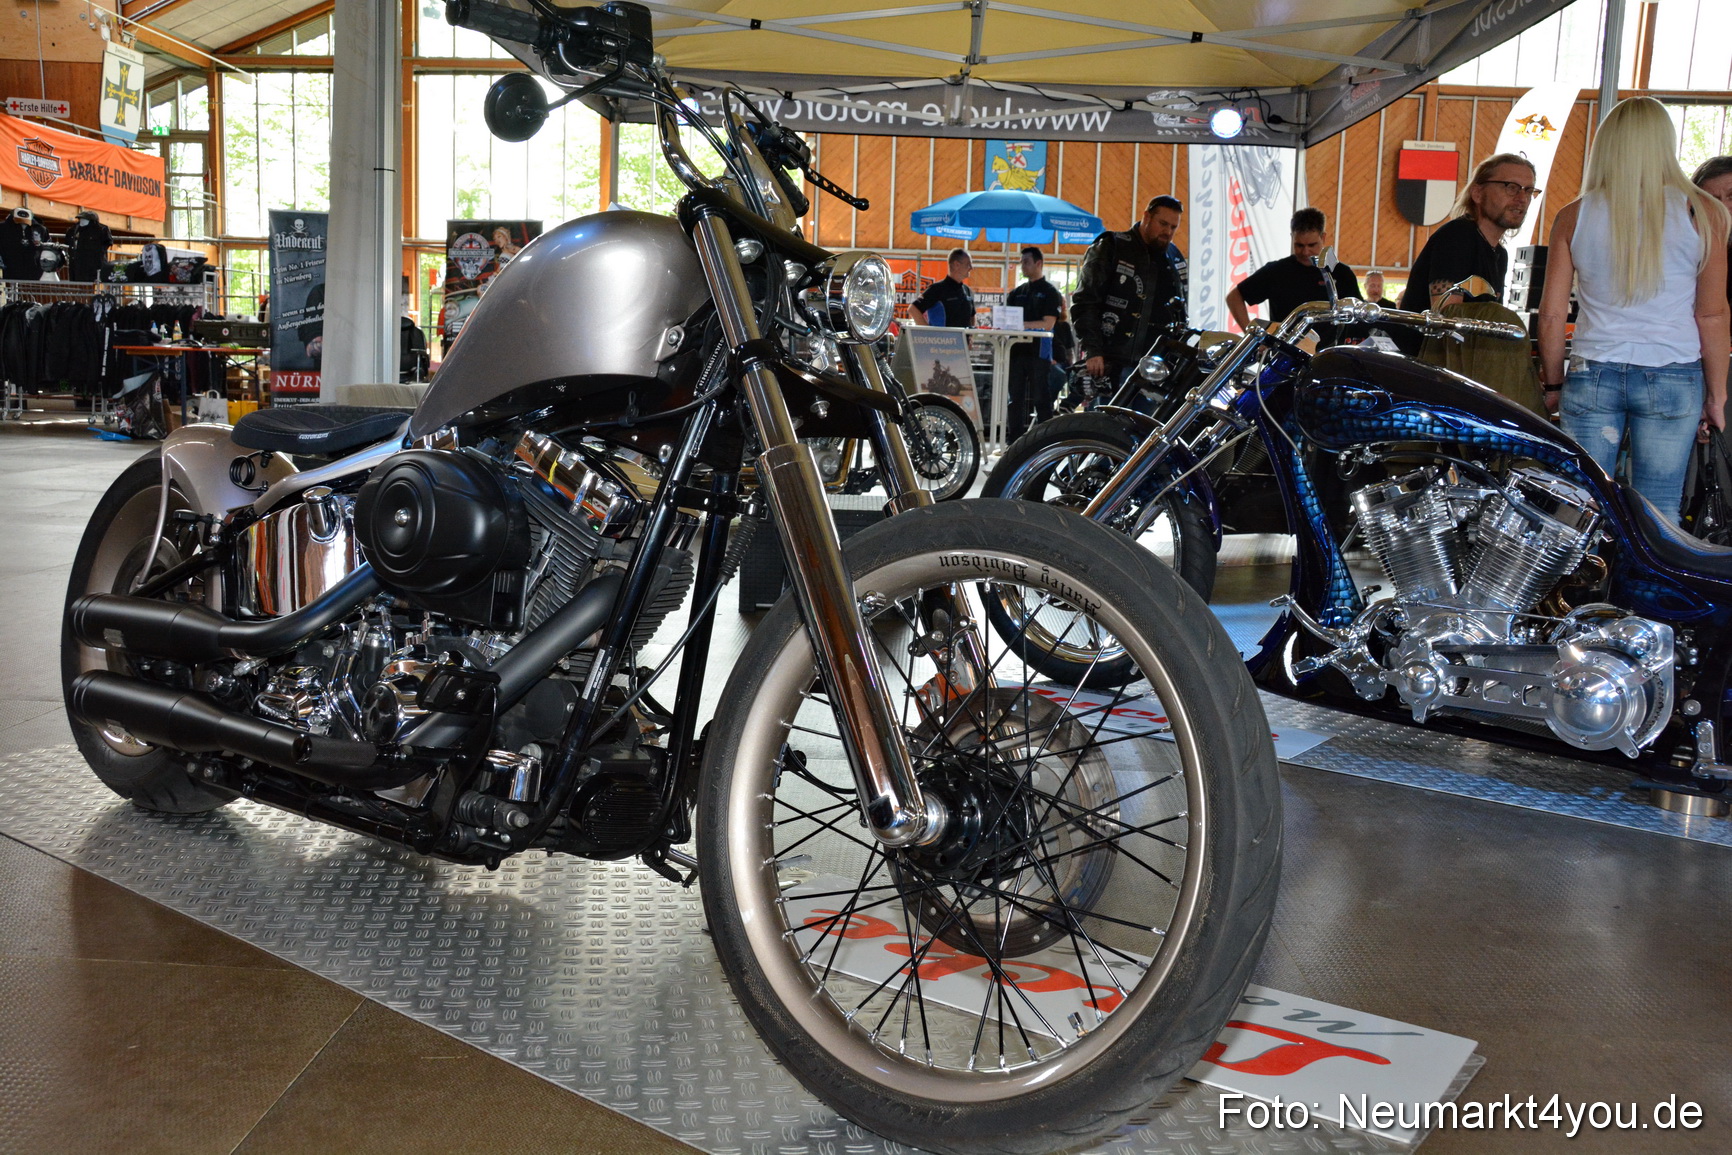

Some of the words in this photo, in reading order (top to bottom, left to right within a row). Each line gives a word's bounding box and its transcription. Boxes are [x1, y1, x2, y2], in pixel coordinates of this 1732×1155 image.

[19, 101, 39, 112] Erste
[40, 103, 58, 113] Hilfe
[67, 159, 161, 198] HARLEY-DAVIDSON
[273, 266, 288, 274] Dein
[284, 273, 312, 283] Nürnberg
[938, 554, 1030, 583] Davidson
[1040, 564, 1102, 617] Harley
